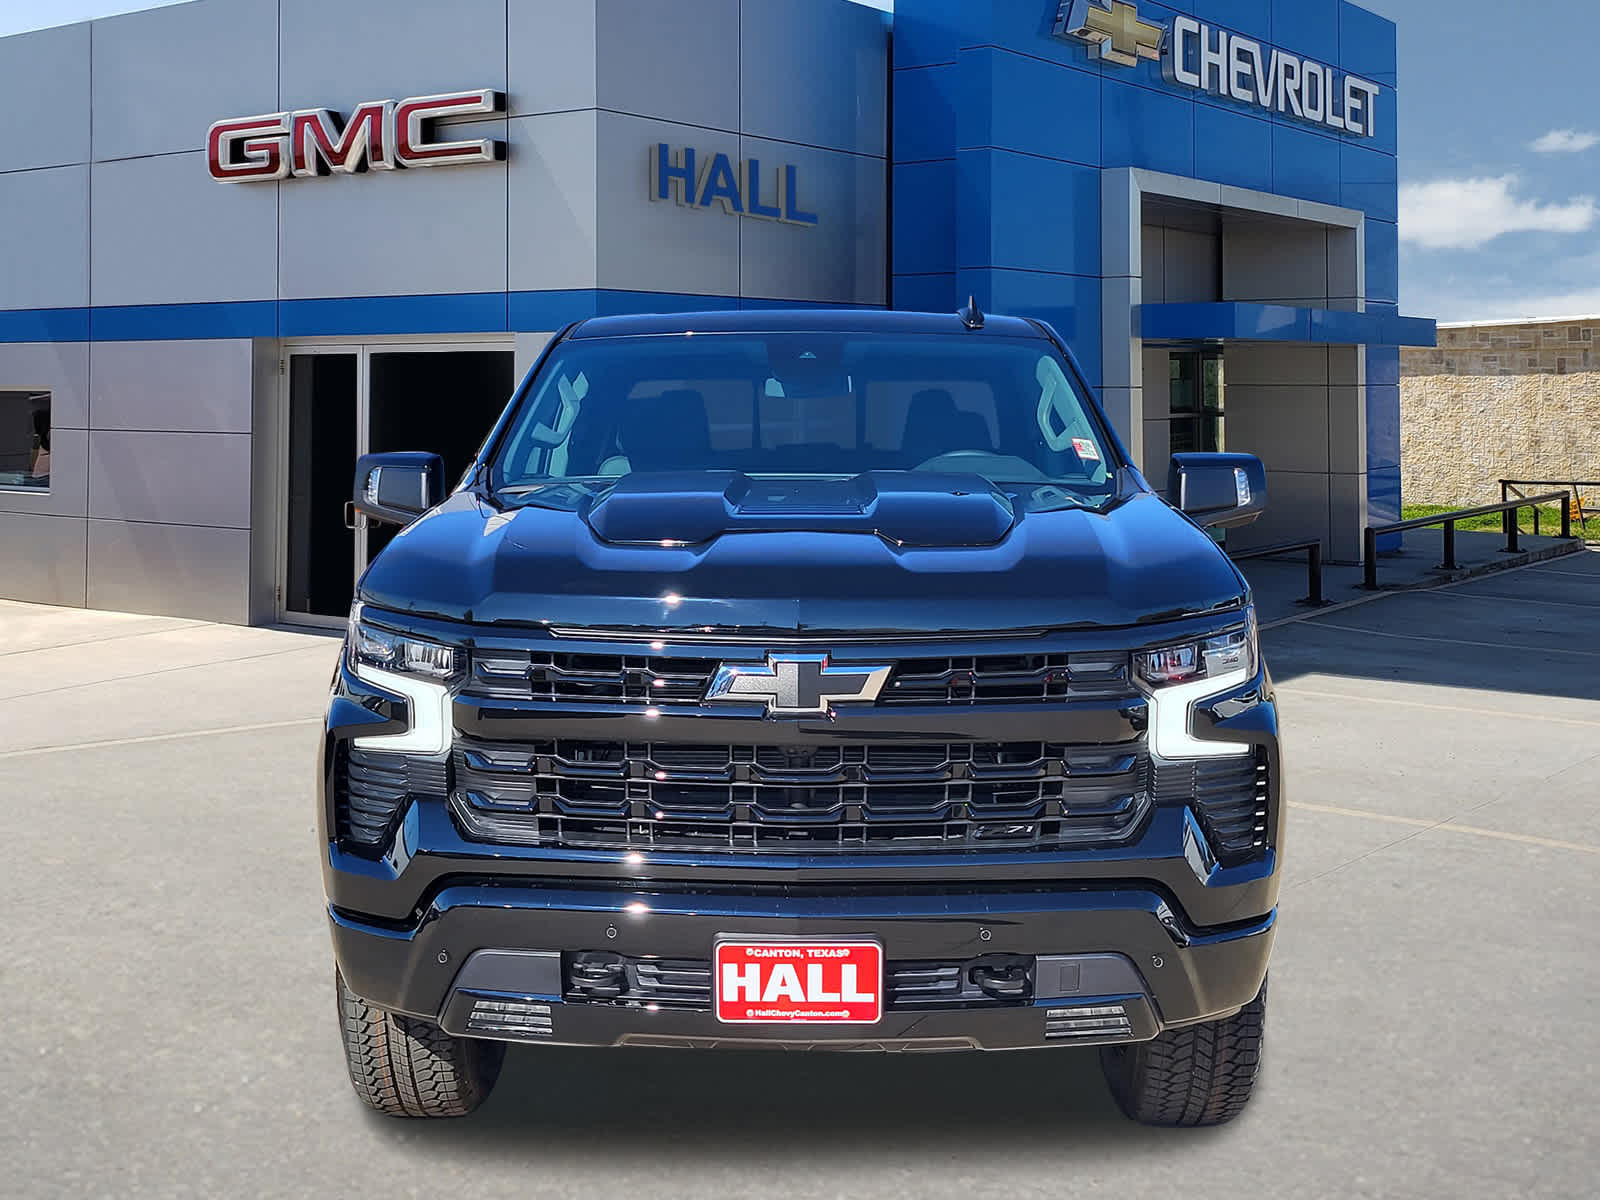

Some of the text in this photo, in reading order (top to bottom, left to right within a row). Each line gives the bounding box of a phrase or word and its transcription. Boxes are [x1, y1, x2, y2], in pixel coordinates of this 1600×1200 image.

[1170, 15, 1380, 137] CHEVROLET
[205, 88, 503, 184] GMC
[652, 143, 818, 225] HALL
[722, 963, 875, 1003] HALL
[753, 948, 845, 959] CANTON, TEXAS
